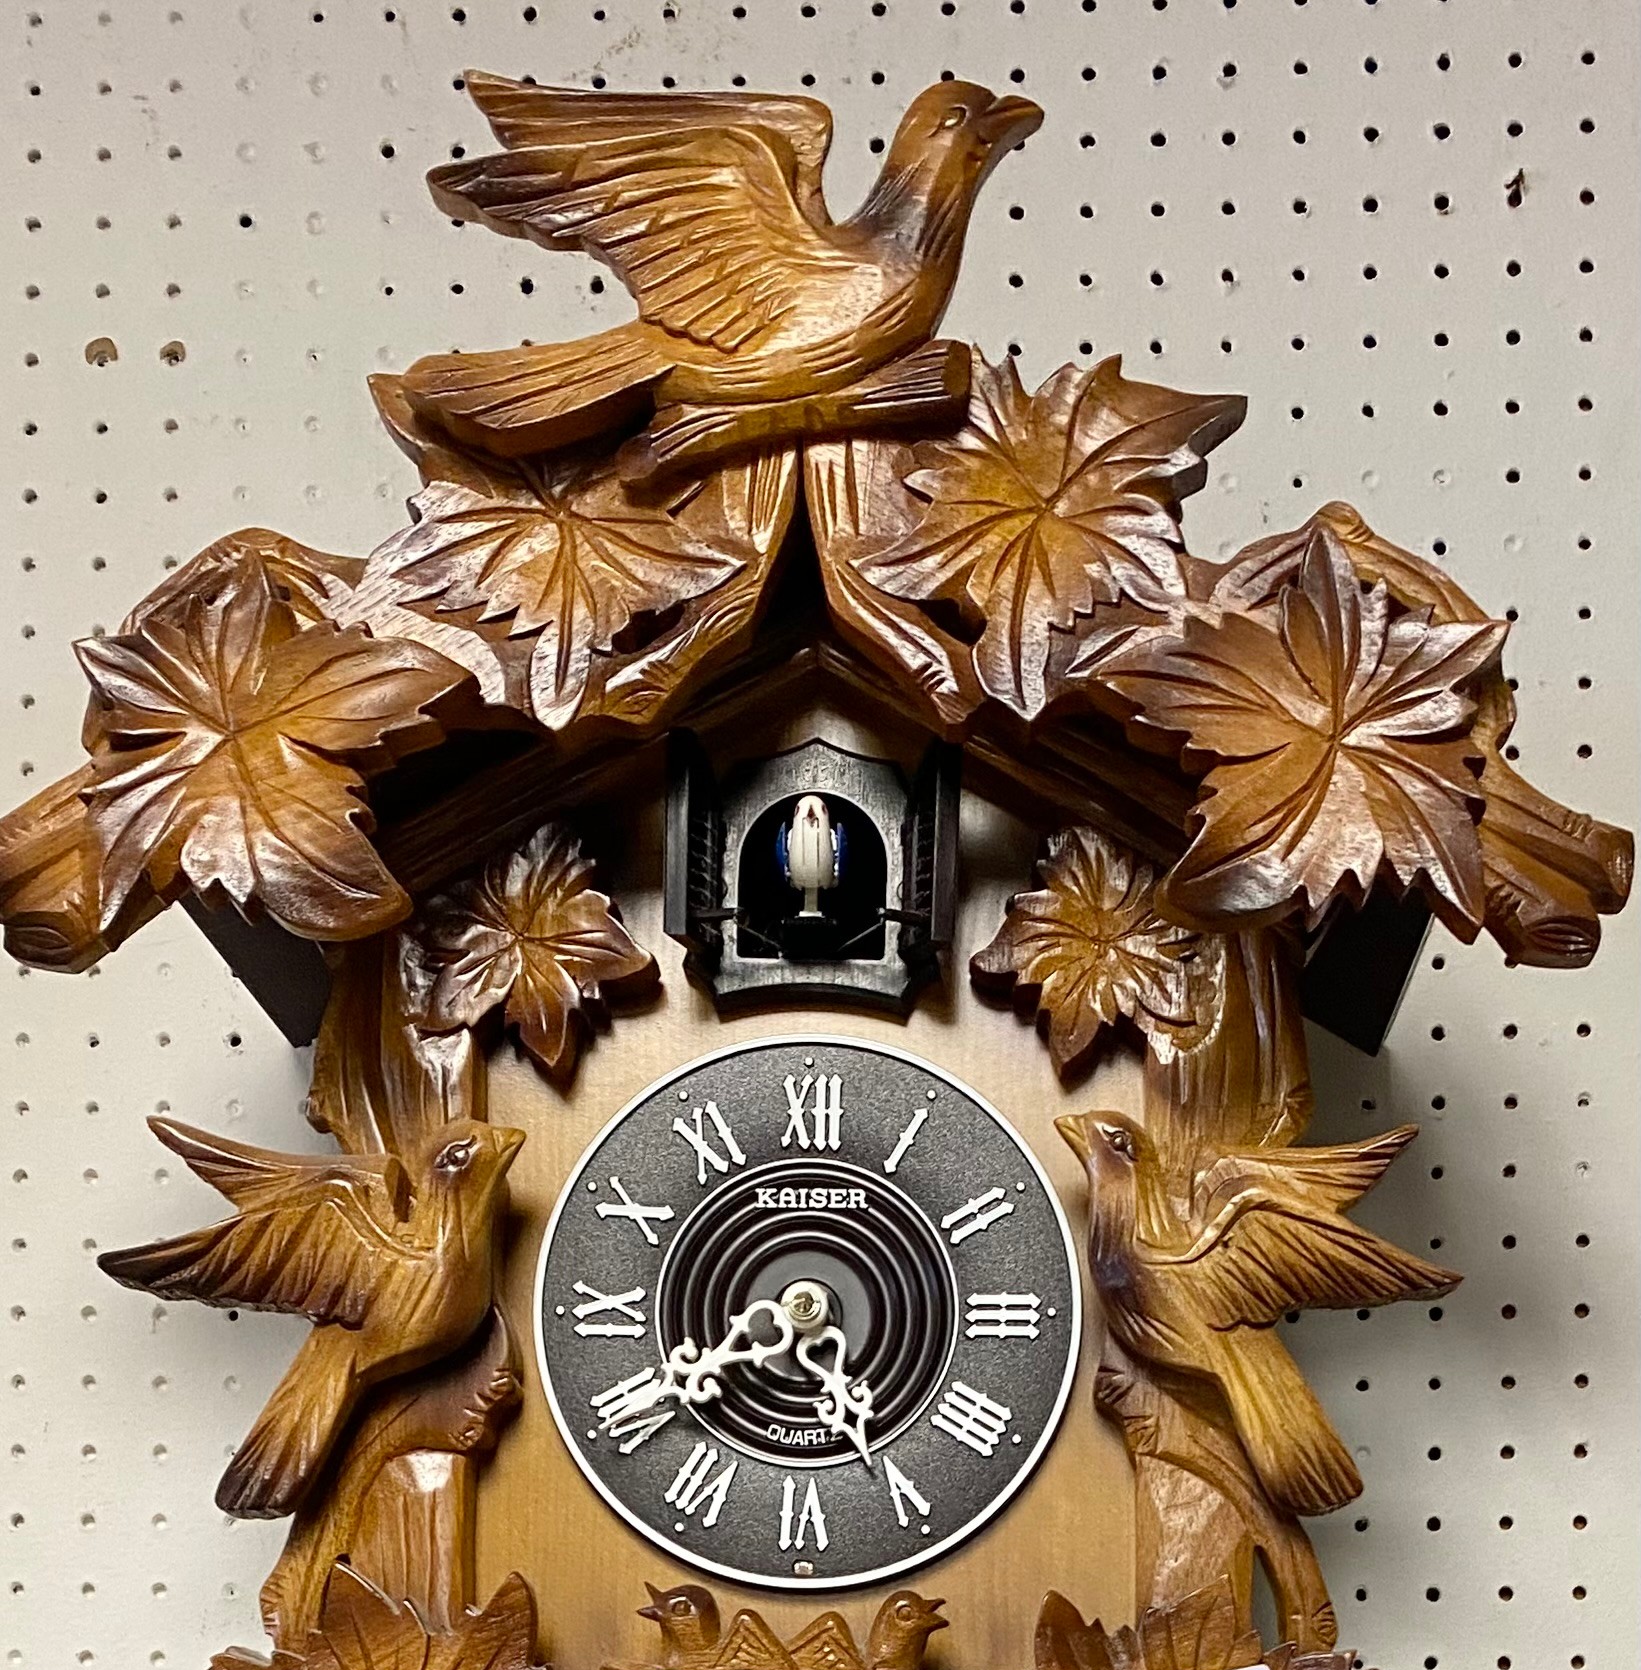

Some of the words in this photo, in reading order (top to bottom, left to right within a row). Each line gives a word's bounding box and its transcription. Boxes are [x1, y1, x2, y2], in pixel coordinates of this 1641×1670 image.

[672, 1100, 747, 1185] XI
[780, 1074, 844, 1151] XII
[883, 1107, 929, 1174] I
[595, 1176, 675, 1245] X
[754, 1187, 869, 1209] KAISER
[940, 1186, 1015, 1244] II
[571, 1280, 647, 1338] IX
[965, 1292, 1042, 1340] III
[589, 1366, 676, 1455] VII
[930, 1381, 1013, 1457] IIII
[664, 1441, 739, 1528] VII
[778, 1474, 829, 1552] VI
[882, 1455, 931, 1528] V
